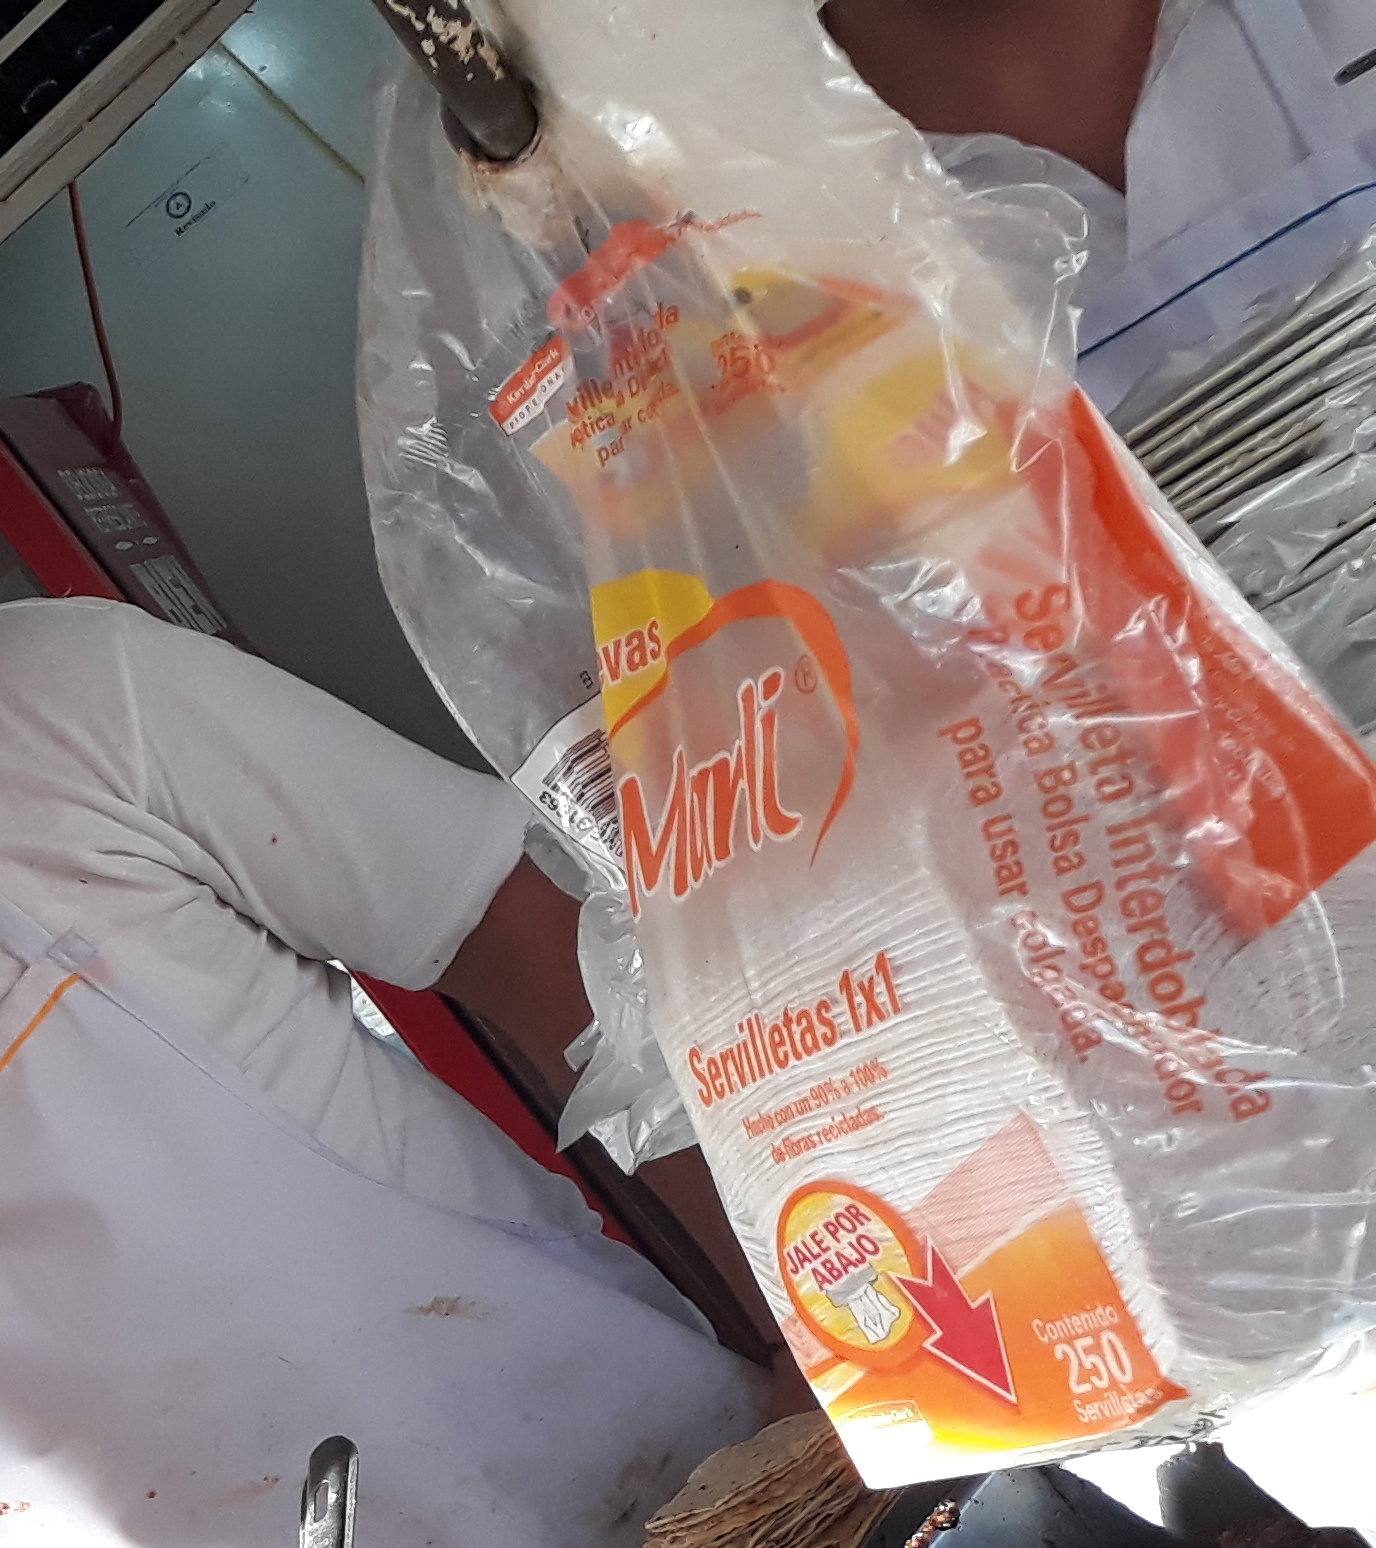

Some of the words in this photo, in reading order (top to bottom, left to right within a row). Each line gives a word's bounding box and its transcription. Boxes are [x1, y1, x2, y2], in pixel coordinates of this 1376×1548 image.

[938, 716, 1004, 807] para
[980, 813, 1030, 896] usar
[1033, 762, 1092, 876] Bolsa
[688, 999, 838, 1108] Servilletas
[838, 951, 902, 1032] 1x1
[774, 1104, 795, 1125] con
[794, 1097, 813, 1116] un
[810, 1077, 842, 1108] 90%
[849, 1057, 889, 1090] 100%
[786, 1230, 831, 1275] JALE
[823, 1203, 872, 1244] POR
[811, 1234, 880, 1291] ABAJO
[1032, 1304, 1118, 1343] Contenido
[1054, 1330, 1134, 1394] 250
